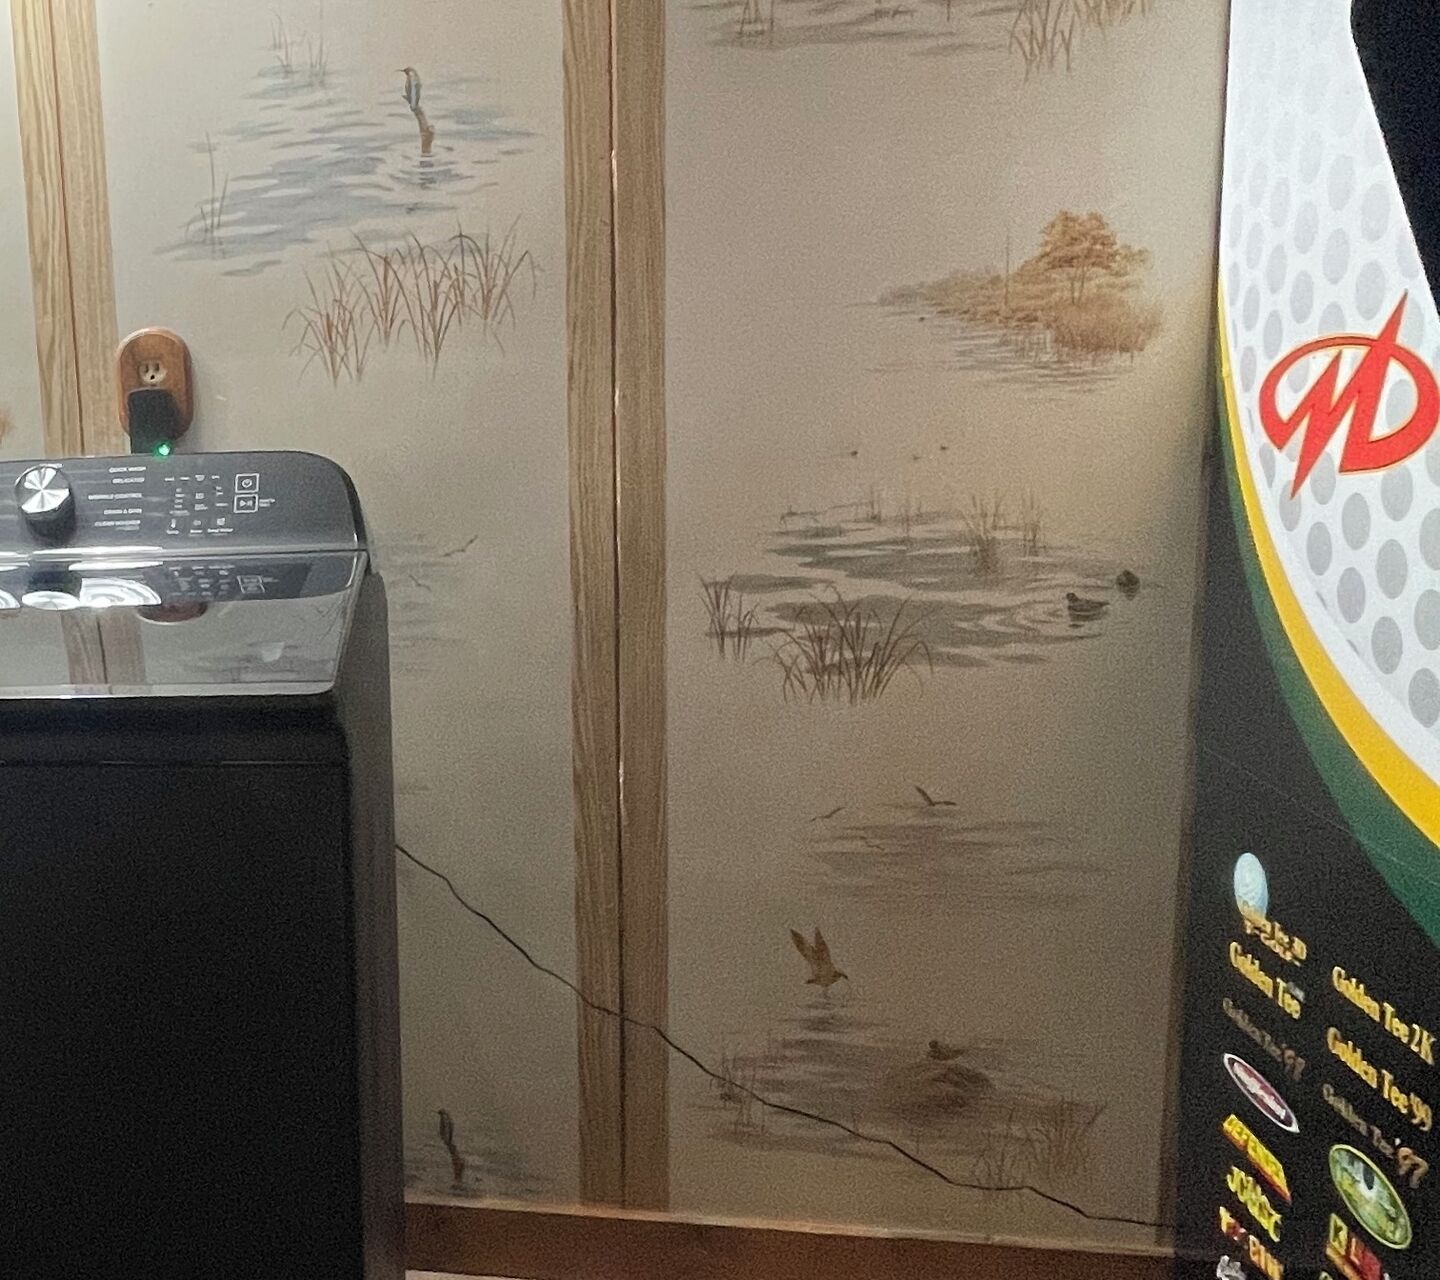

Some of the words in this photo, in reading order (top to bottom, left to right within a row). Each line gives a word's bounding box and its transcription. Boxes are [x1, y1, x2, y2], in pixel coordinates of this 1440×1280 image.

[1229, 941, 1274, 999] Golden
[1276, 977, 1301, 1020] Tee
[1331, 966, 1380, 1022] Golden
[1382, 1002, 1409, 1044] Tee
[1410, 1023, 1436, 1066] 2K
[1327, 1026, 1378, 1089] Golden
[1380, 1070, 1408, 1114] Tee
